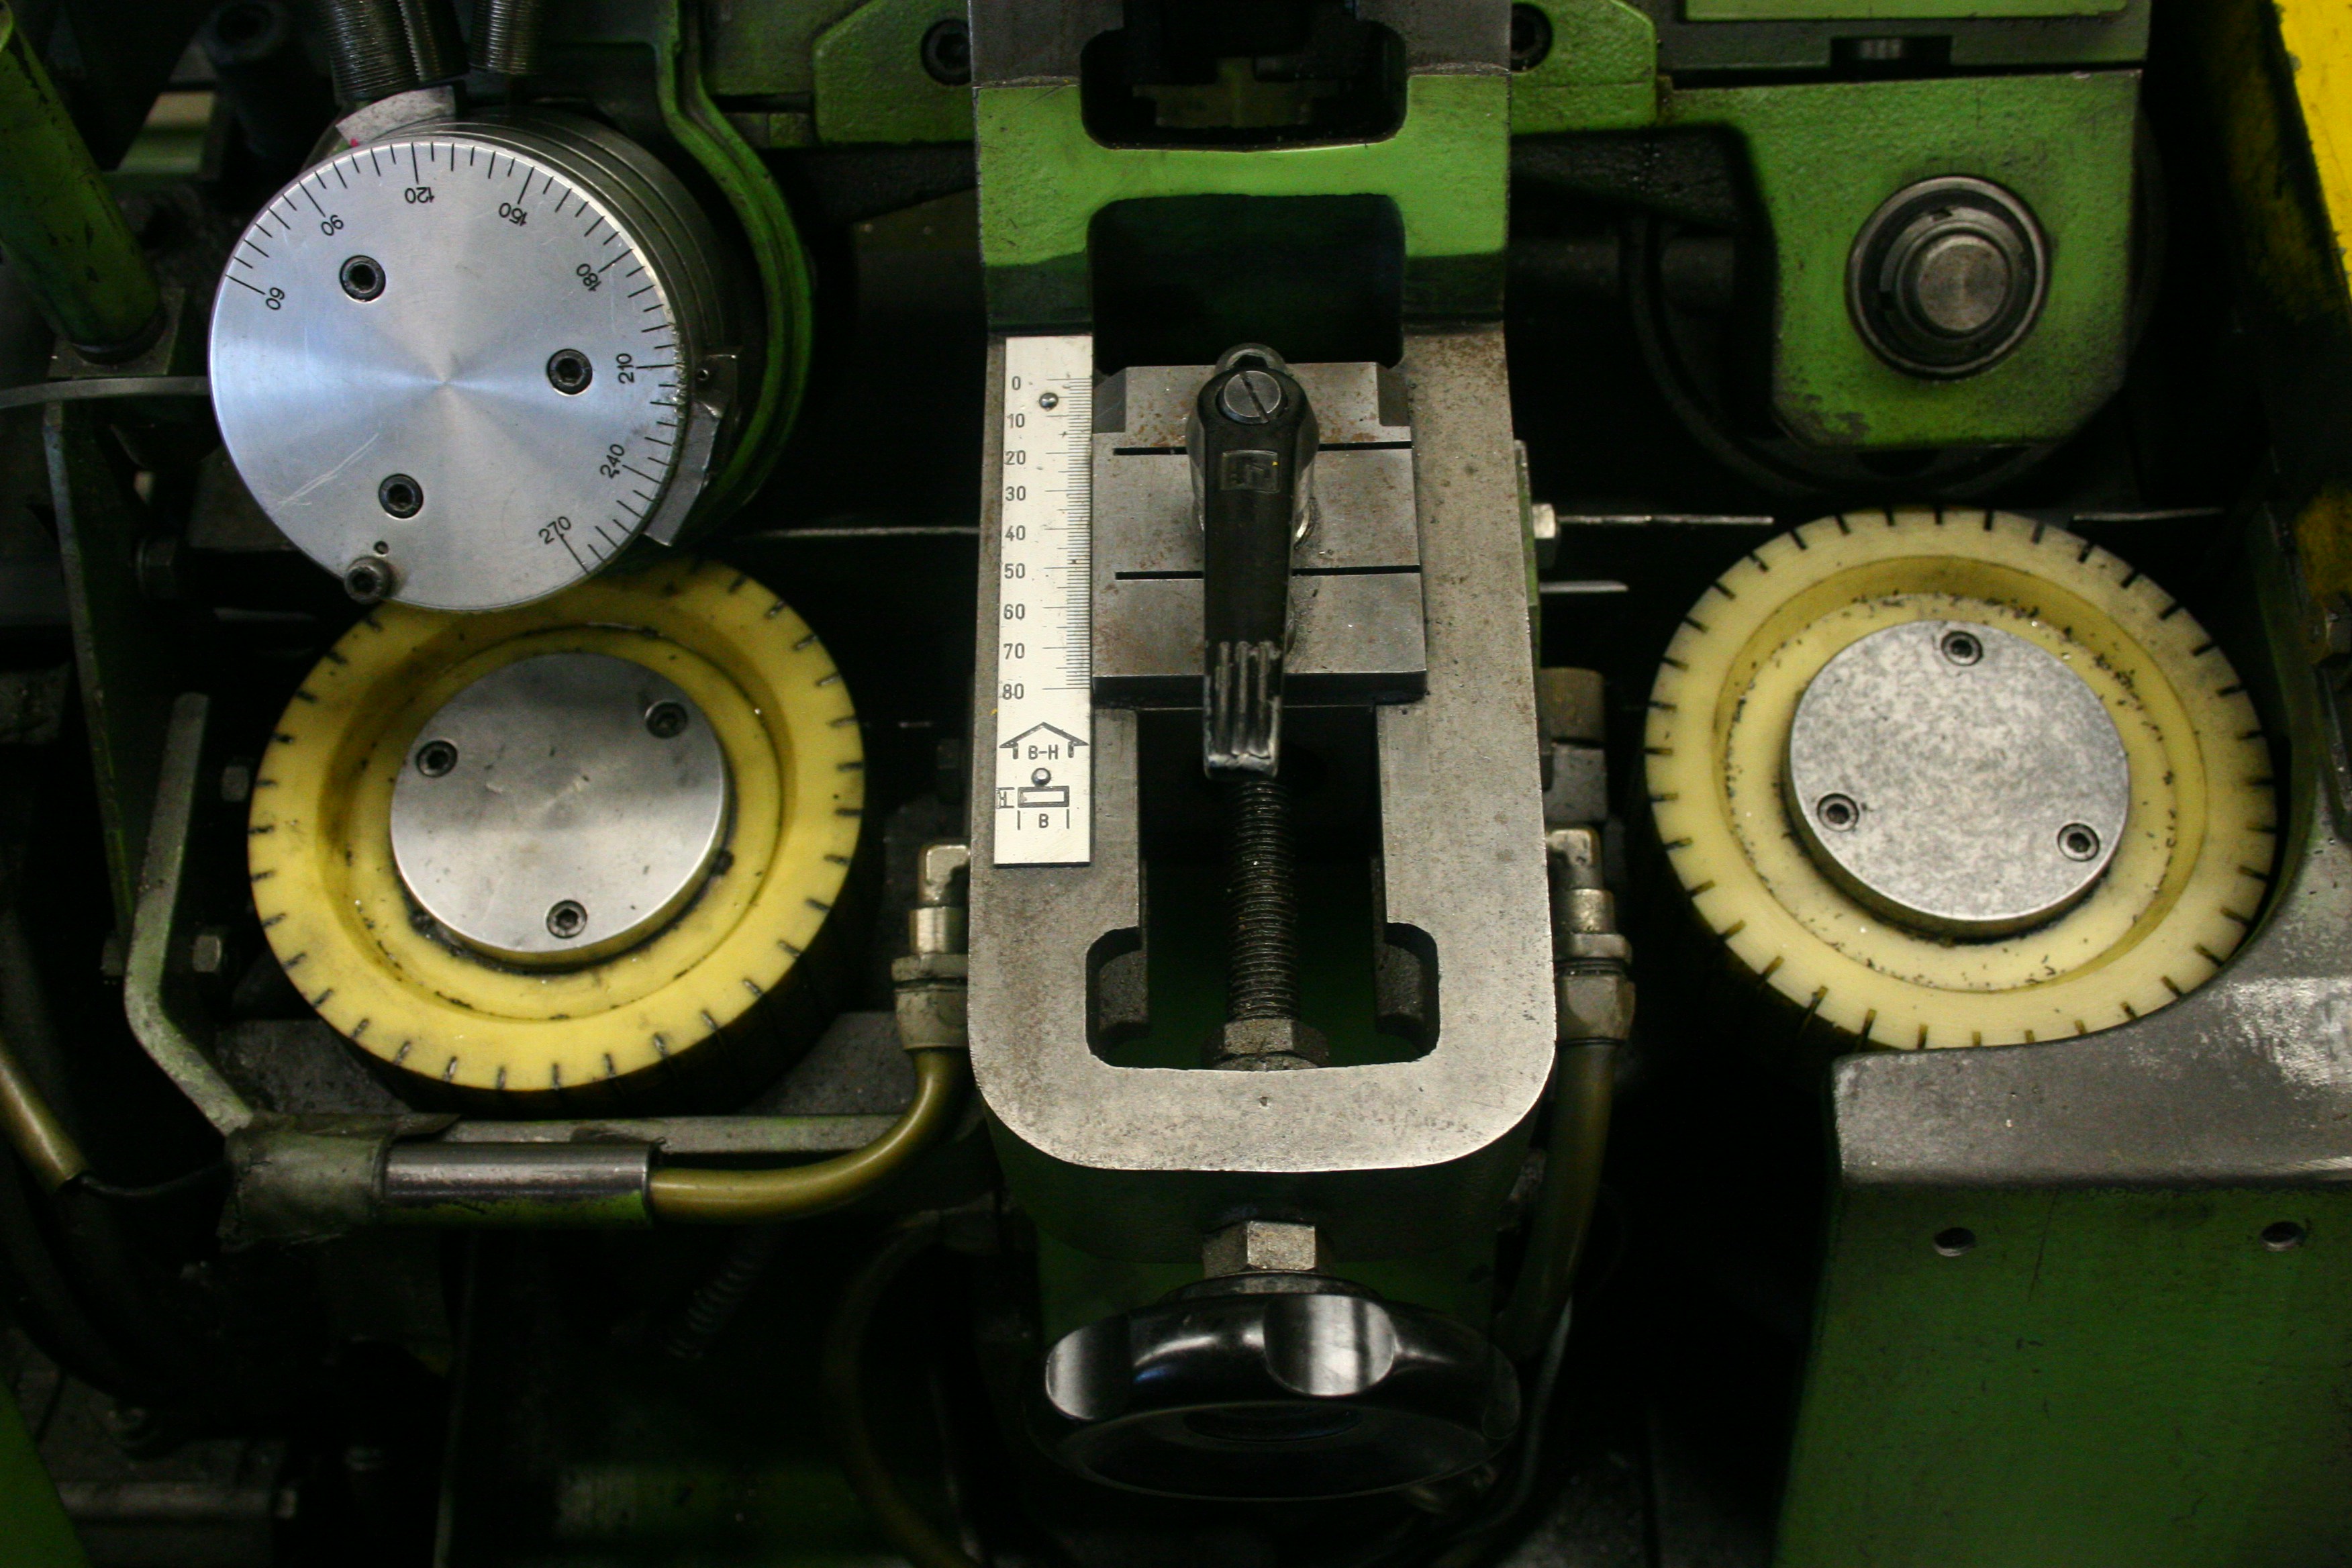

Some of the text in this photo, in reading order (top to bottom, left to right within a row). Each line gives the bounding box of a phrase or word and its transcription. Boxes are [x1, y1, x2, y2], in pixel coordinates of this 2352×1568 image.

[404, 186, 435, 204] 120
[498, 201, 528, 227] 150
[321, 214, 344, 237] 90
[576, 262, 602, 293] 180
[265, 287, 286, 311] 60
[616, 352, 635, 384] 210
[1012, 376, 1022, 391] 0
[1008, 413, 1025, 428] 10
[599, 443, 626, 479] 240
[1005, 450, 1026, 465] 20
[1005, 485, 1026, 501] 30
[538, 516, 572, 544] 270
[1005, 525, 1026, 541] 40
[1004, 562, 1026, 579] 50
[1003, 603, 1025, 620] 60
[1003, 642, 1025, 659] 70
[1002, 683, 1024, 699] 80
[1028, 744, 1059, 760] B-H
[1038, 813, 1048, 829] B
